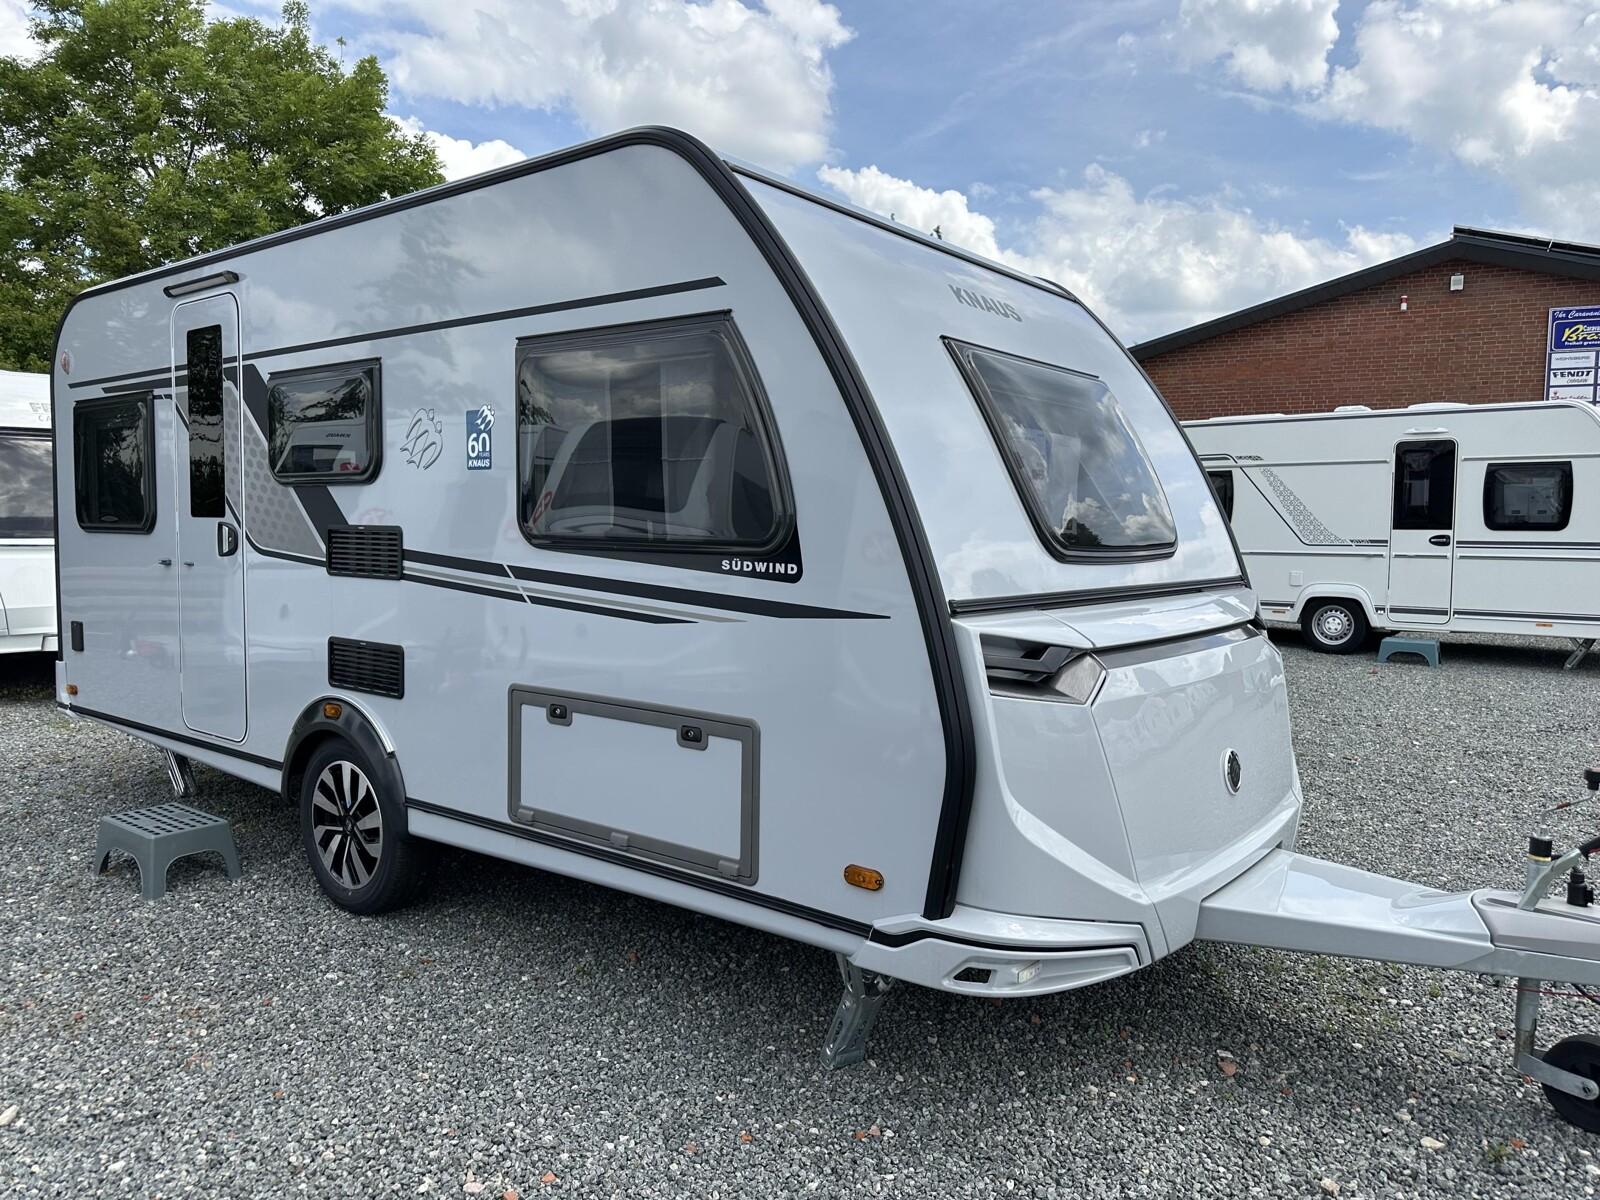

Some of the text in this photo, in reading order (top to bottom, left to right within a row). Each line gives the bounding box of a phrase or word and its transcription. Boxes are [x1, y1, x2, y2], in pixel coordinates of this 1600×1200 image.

[947, 283, 1022, 322] KNAUS
[1552, 370, 1593, 378] FENDT
[468, 432, 490, 458] 60
[468, 459, 490, 468] KNAUS
[721, 558, 798, 575] SÜDWIND
